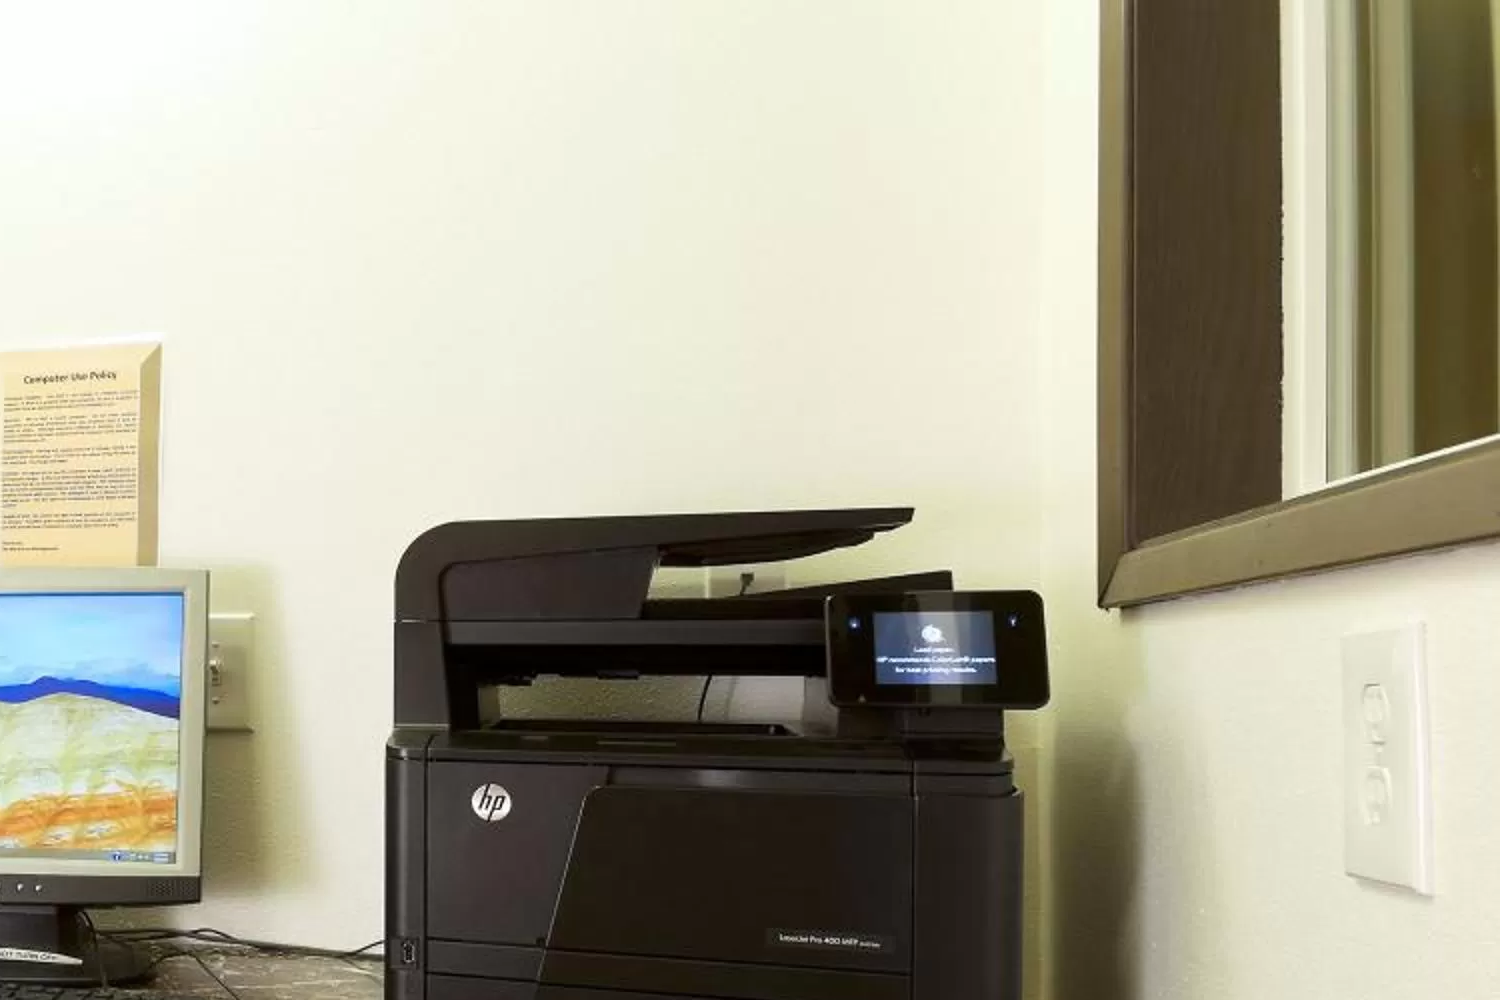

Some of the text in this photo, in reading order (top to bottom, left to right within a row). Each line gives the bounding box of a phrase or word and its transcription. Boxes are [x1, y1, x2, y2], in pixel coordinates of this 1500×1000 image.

[23, 370, 117, 385] Computer Use Policy
[474, 783, 510, 822] hp
[809, 935, 822, 945] Pro
[824, 937, 840, 945] 400
